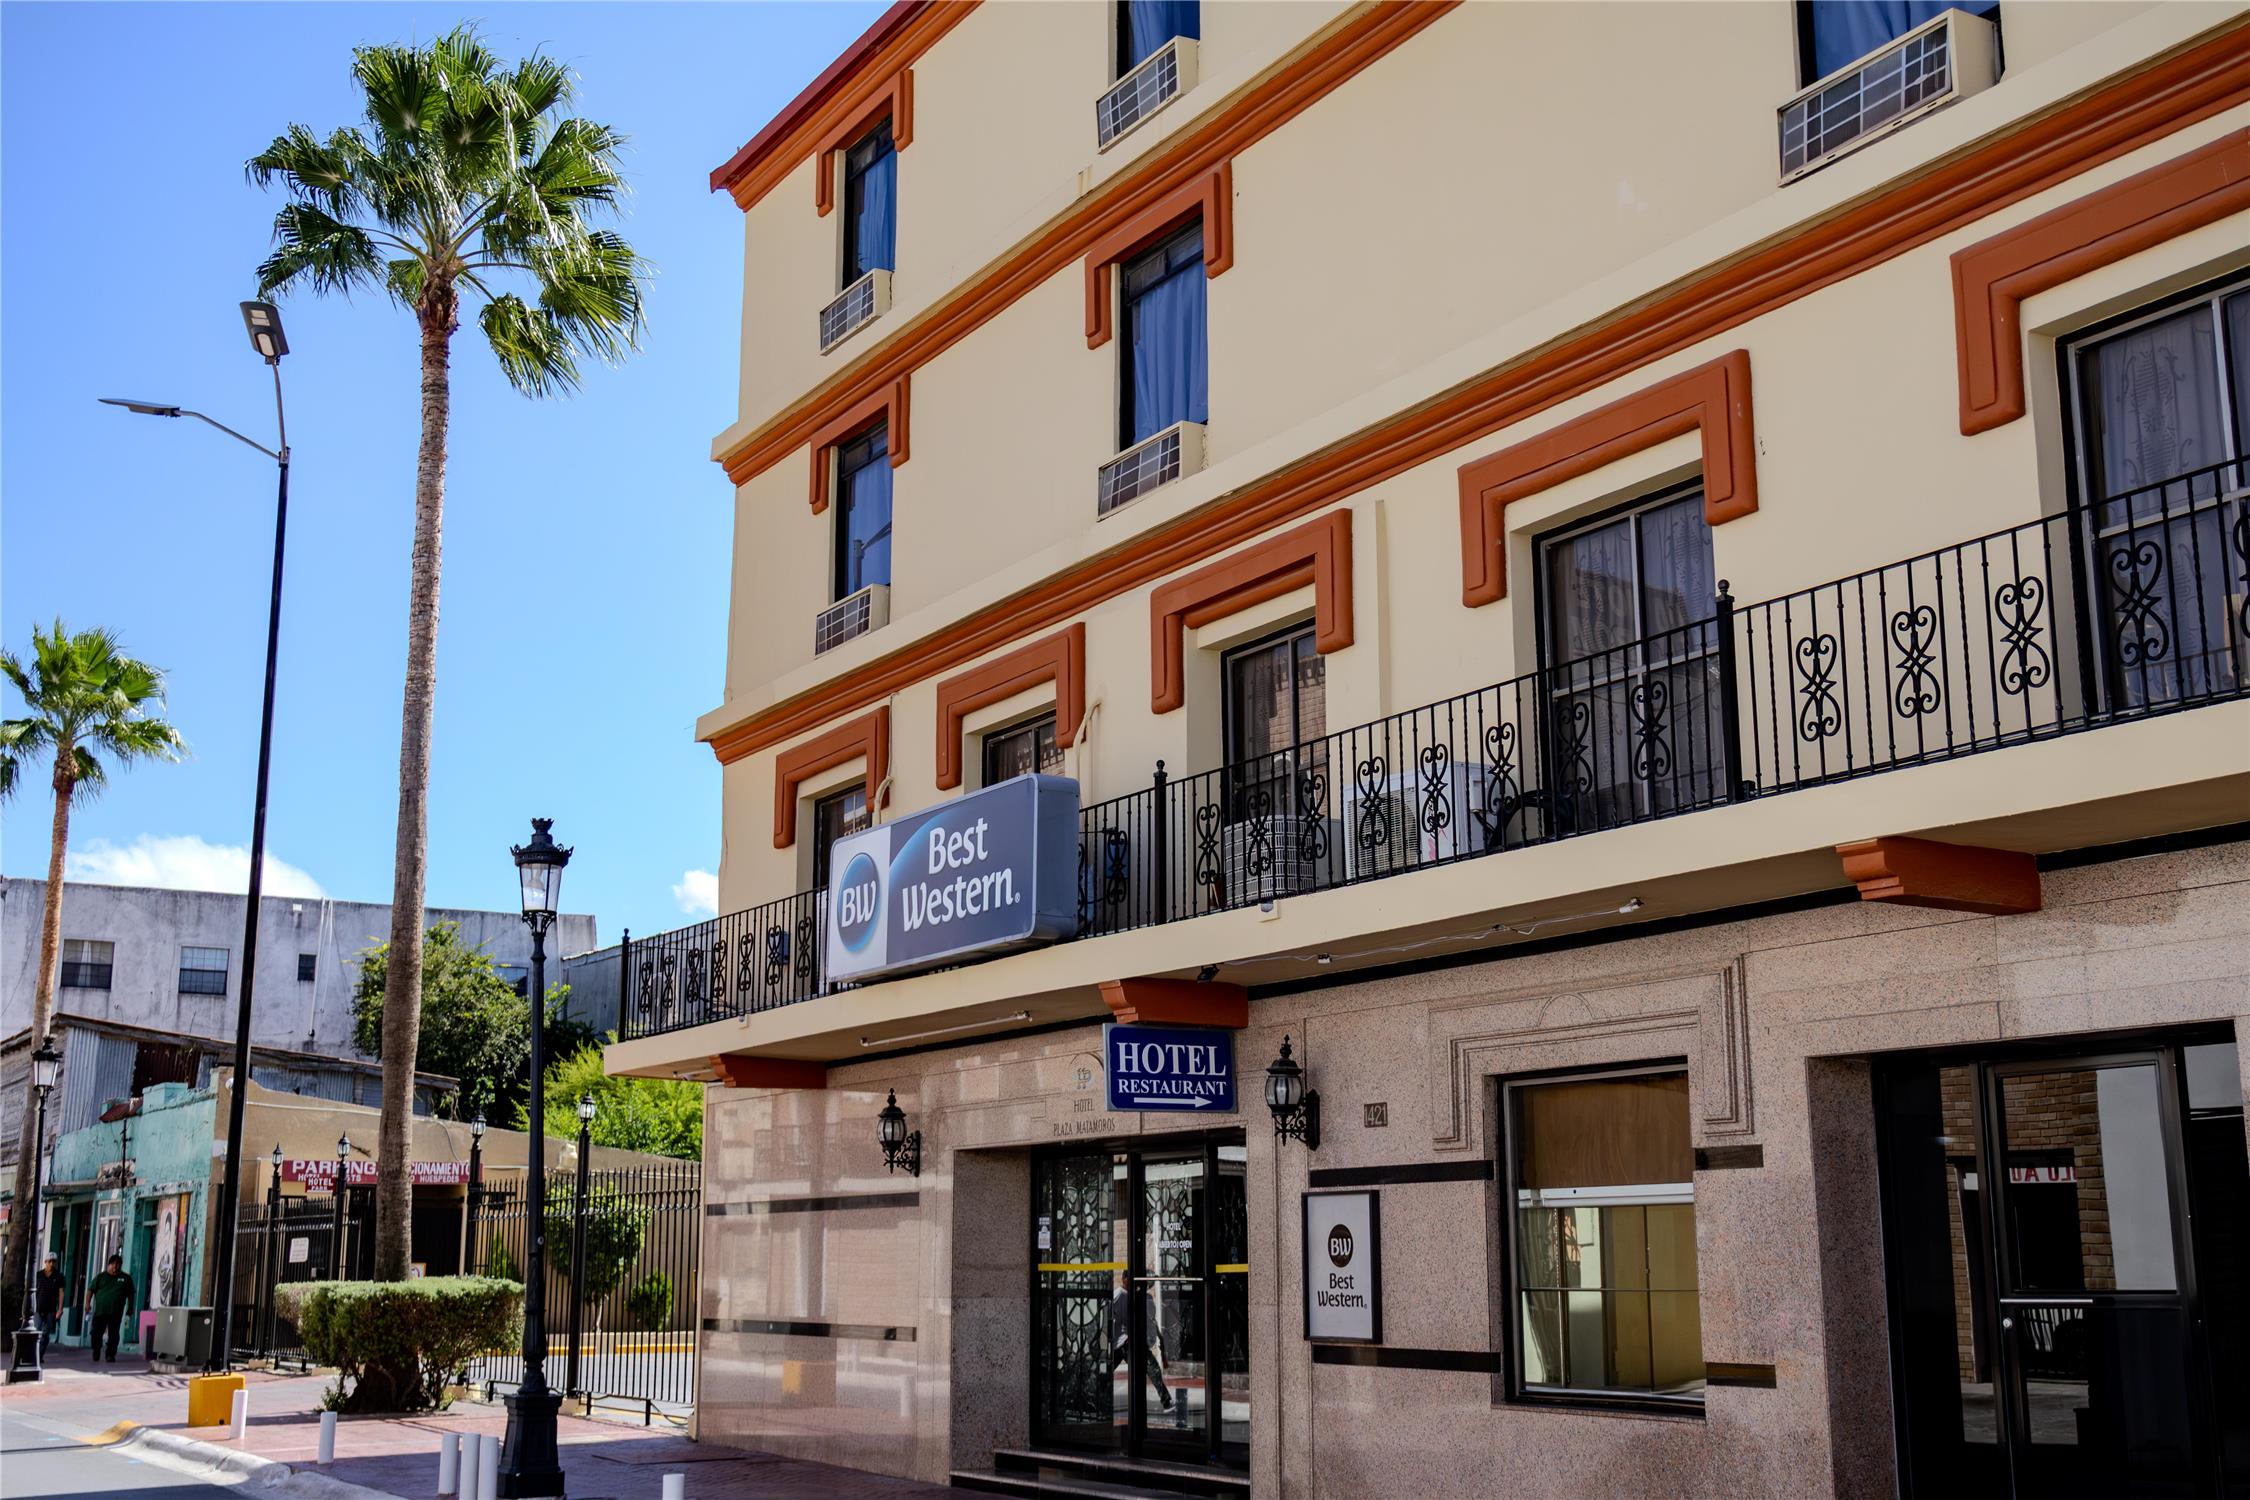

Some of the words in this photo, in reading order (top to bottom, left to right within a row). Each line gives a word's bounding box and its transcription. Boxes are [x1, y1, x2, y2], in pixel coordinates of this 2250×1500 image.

[929, 817, 988, 875] Best
[841, 880, 877, 928] BW
[1116, 1042, 1227, 1076] HOTEL
[1118, 1079, 1226, 1095] RESTAURANT
[1073, 1099, 1094, 1113] HOTEL
[1364, 1104, 1387, 1126] 1421
[1053, 1122, 1073, 1137] PLAZA
[1076, 1117, 1116, 1134] MATAMOROS
[308, 1178, 333, 1186] HOTEL
[1330, 1238, 1352, 1256] BW
[1329, 1273, 1354, 1289] Best
